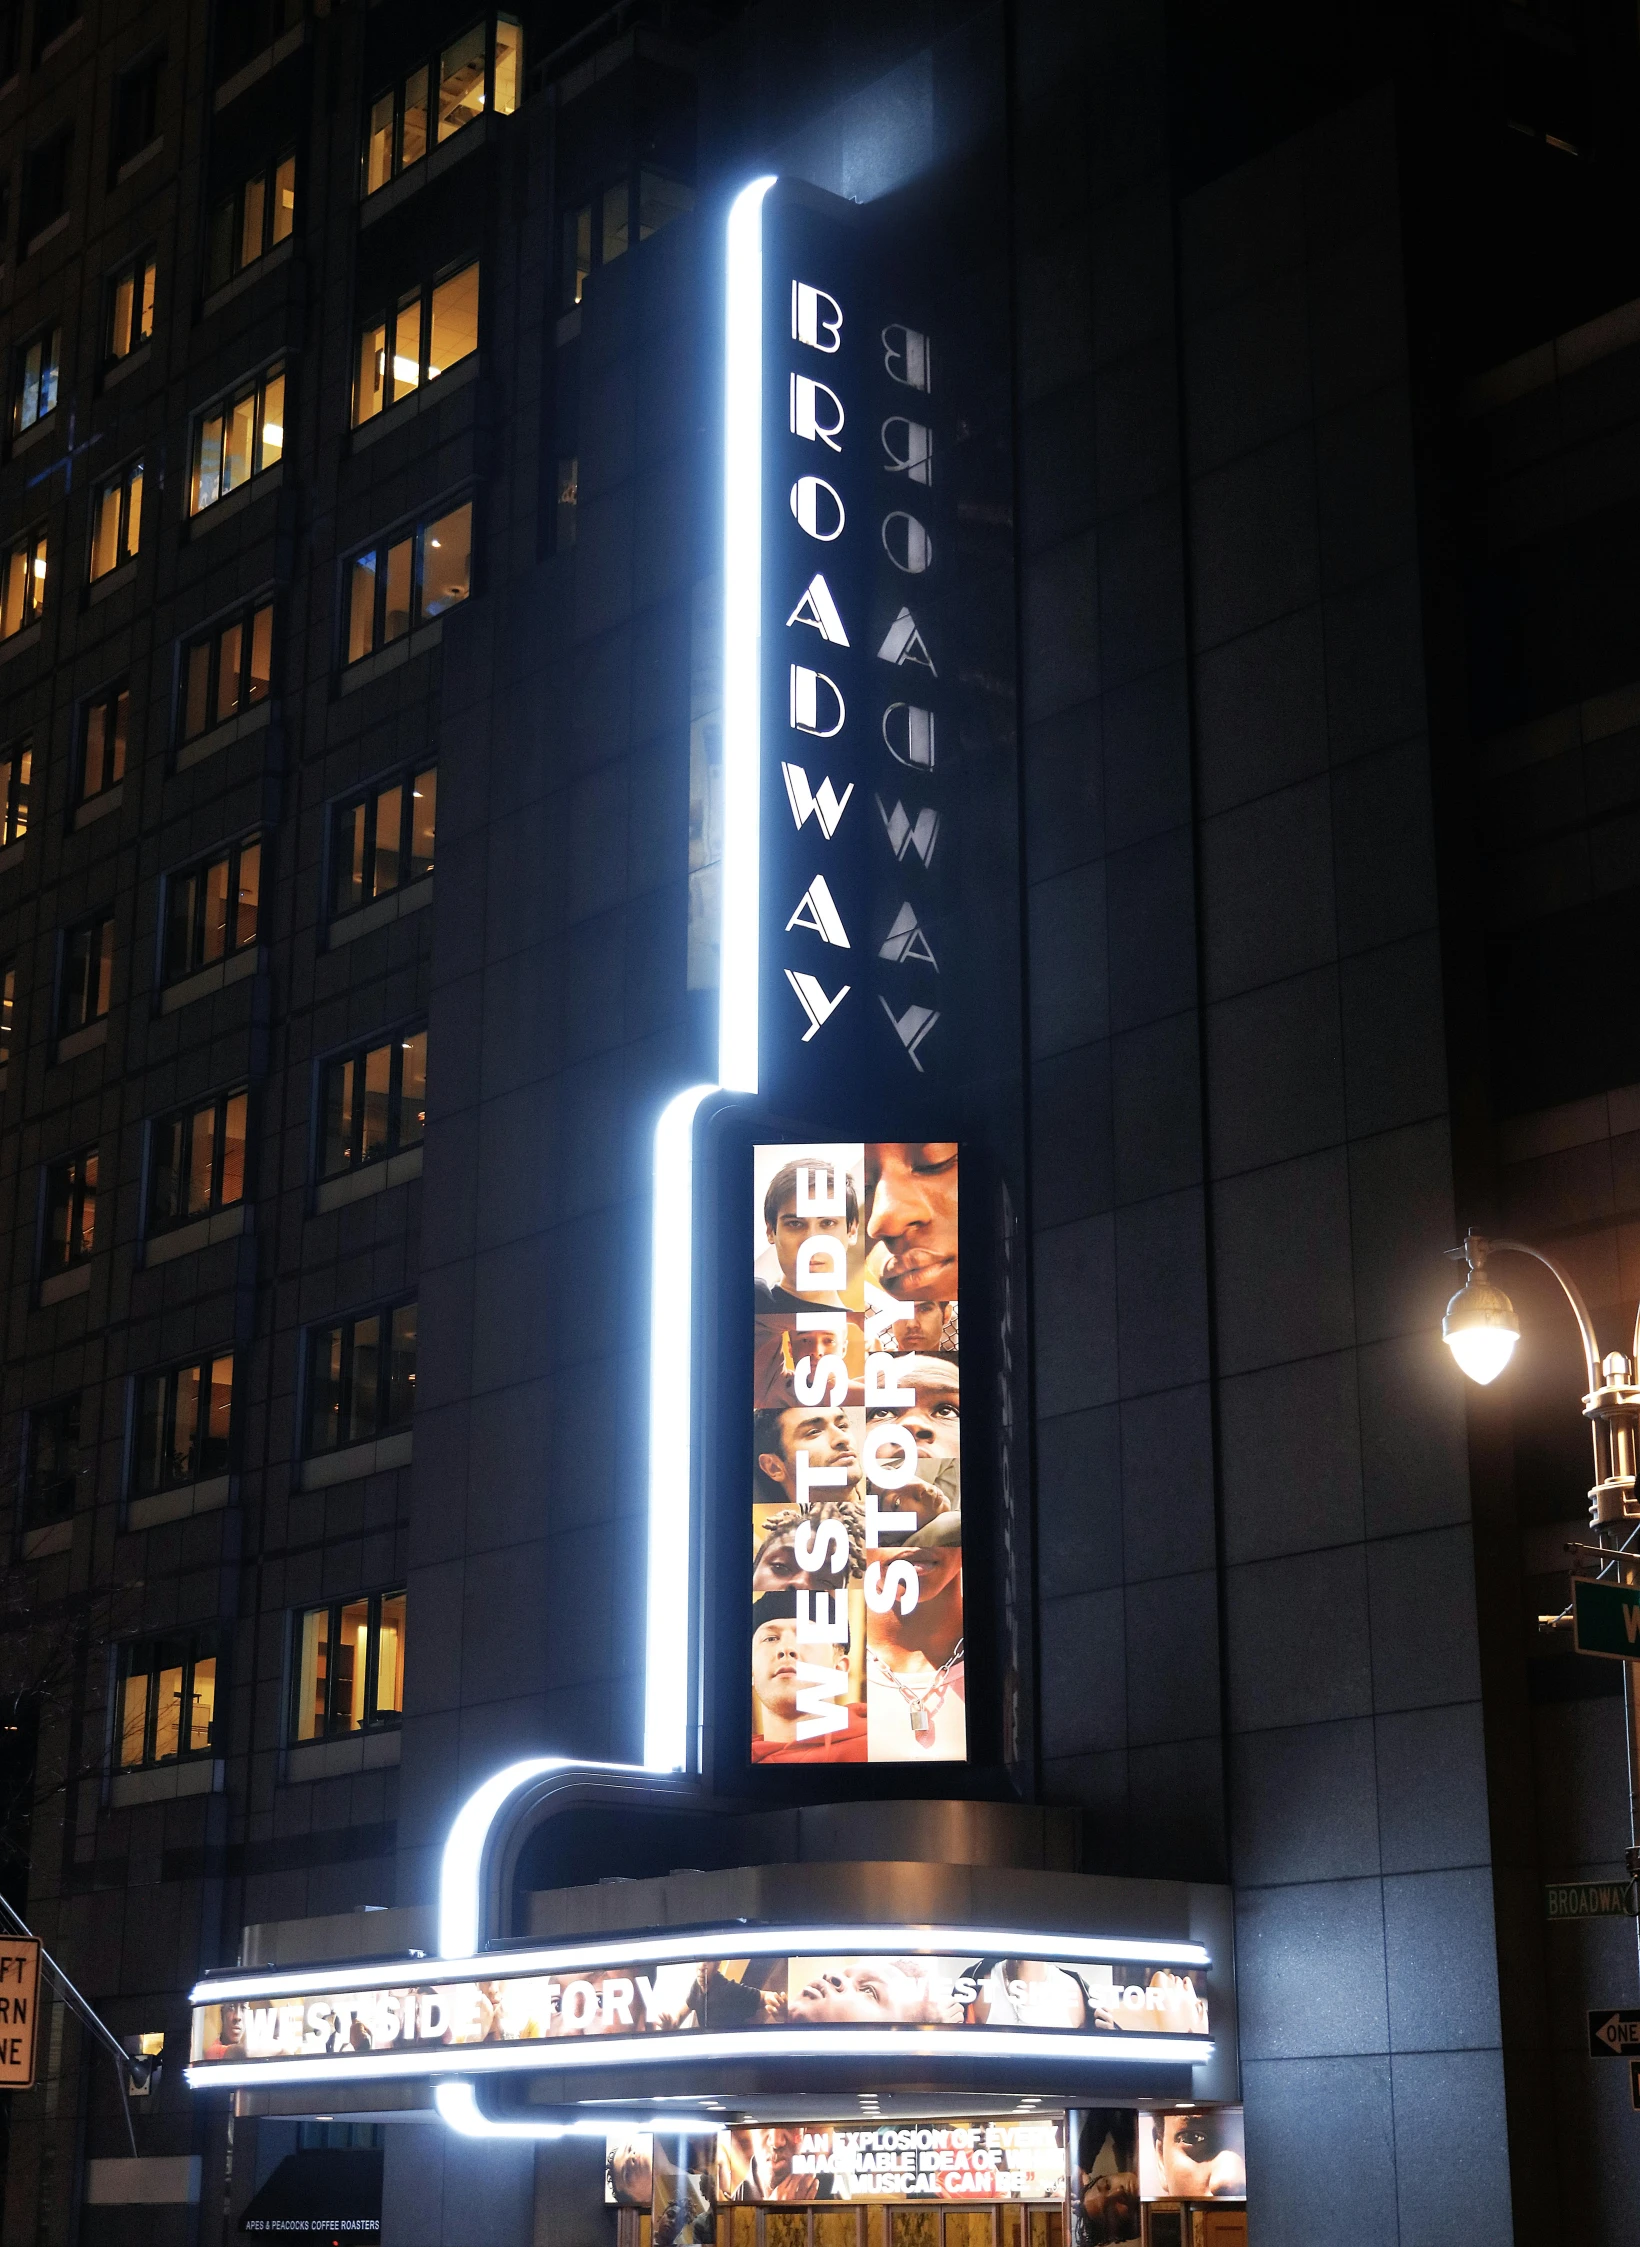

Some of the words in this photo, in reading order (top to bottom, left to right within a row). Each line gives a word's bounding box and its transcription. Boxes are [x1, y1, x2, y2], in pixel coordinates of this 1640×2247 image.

[780, 279, 854, 1042] BROADWAY
[795, 1166, 847, 1408] SIDE
[863, 1293, 919, 1616] STORY
[795, 1449, 849, 1744] WEST
[1548, 1886, 1629, 1915] BROADWAY
[1008, 1979, 1079, 2008] SIE
[245, 1999, 361, 2051] WEST
[372, 1989, 482, 2043] SIDE
[500, 1975, 668, 2036] TORY
[1606, 2023, 1639, 2043] ONE
[833, 2129, 948, 2152] EXPLOSION
[950, 2127, 982, 2150] OF
[986, 2126, 1059, 2150] EVERY
[792, 2153, 917, 2174] IMAGNABLE
[919, 2150, 970, 2172] IDEA
[971, 2149, 1002, 2171] OF
[1006, 2147, 1066, 2170] WHT
[831, 2173, 849, 2194] A
[850, 2172, 940, 2194] MUSICAL
[944, 2172, 991, 2193] CAN
[246, 2220, 264, 2230] APES
[265, 2220, 271, 2230] &
[271, 2220, 310, 2231] PEACOCKS
[311, 2220, 340, 2231] COFFEE
[341, 2219, 380, 2231] ROASTERS
